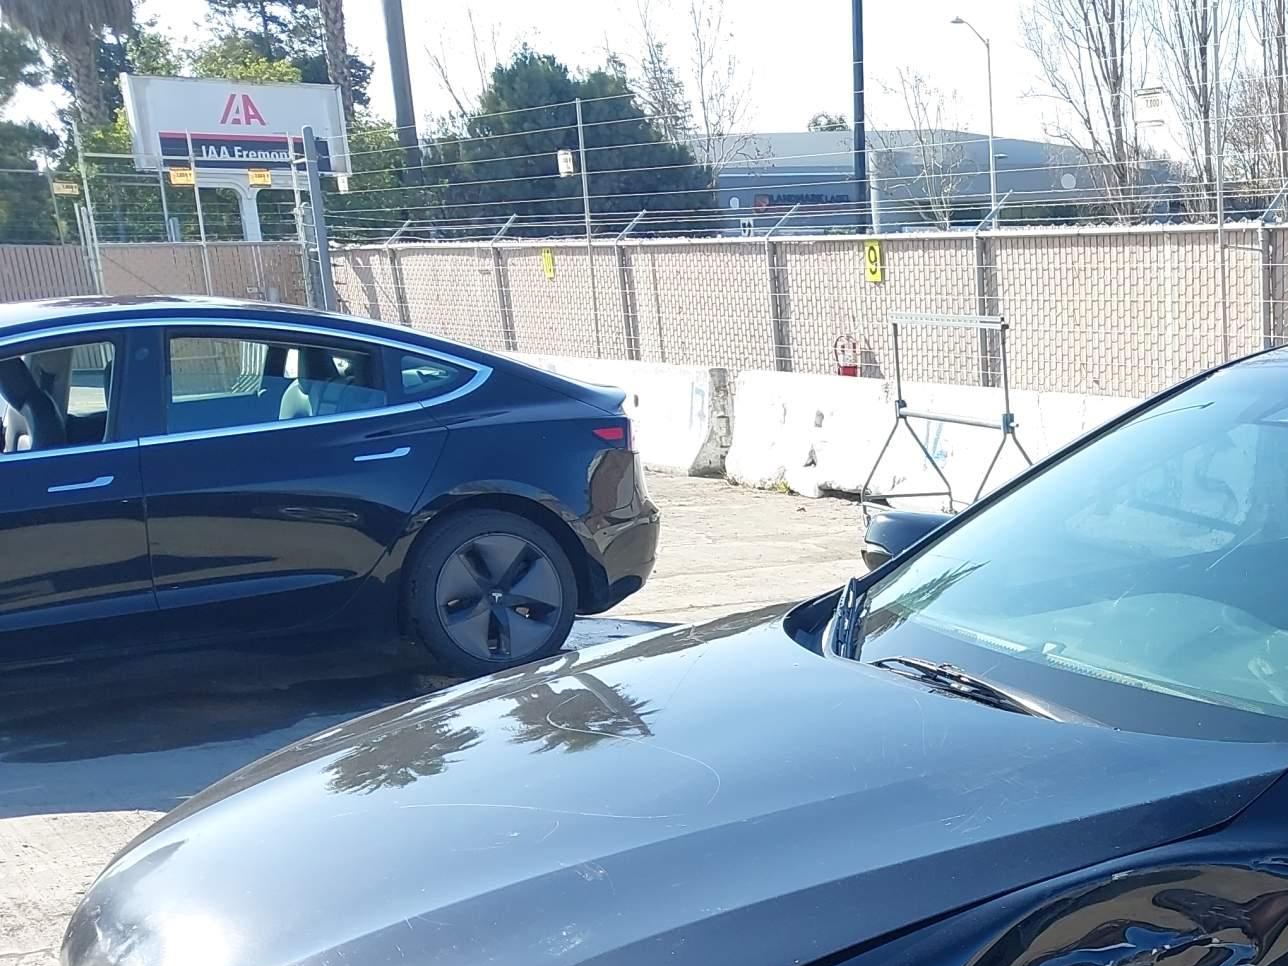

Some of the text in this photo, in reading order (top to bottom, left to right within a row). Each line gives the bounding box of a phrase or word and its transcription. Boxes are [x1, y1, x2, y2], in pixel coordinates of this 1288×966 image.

[201, 145, 293, 161] IAA Fremon
[868, 245, 878, 275] 9
